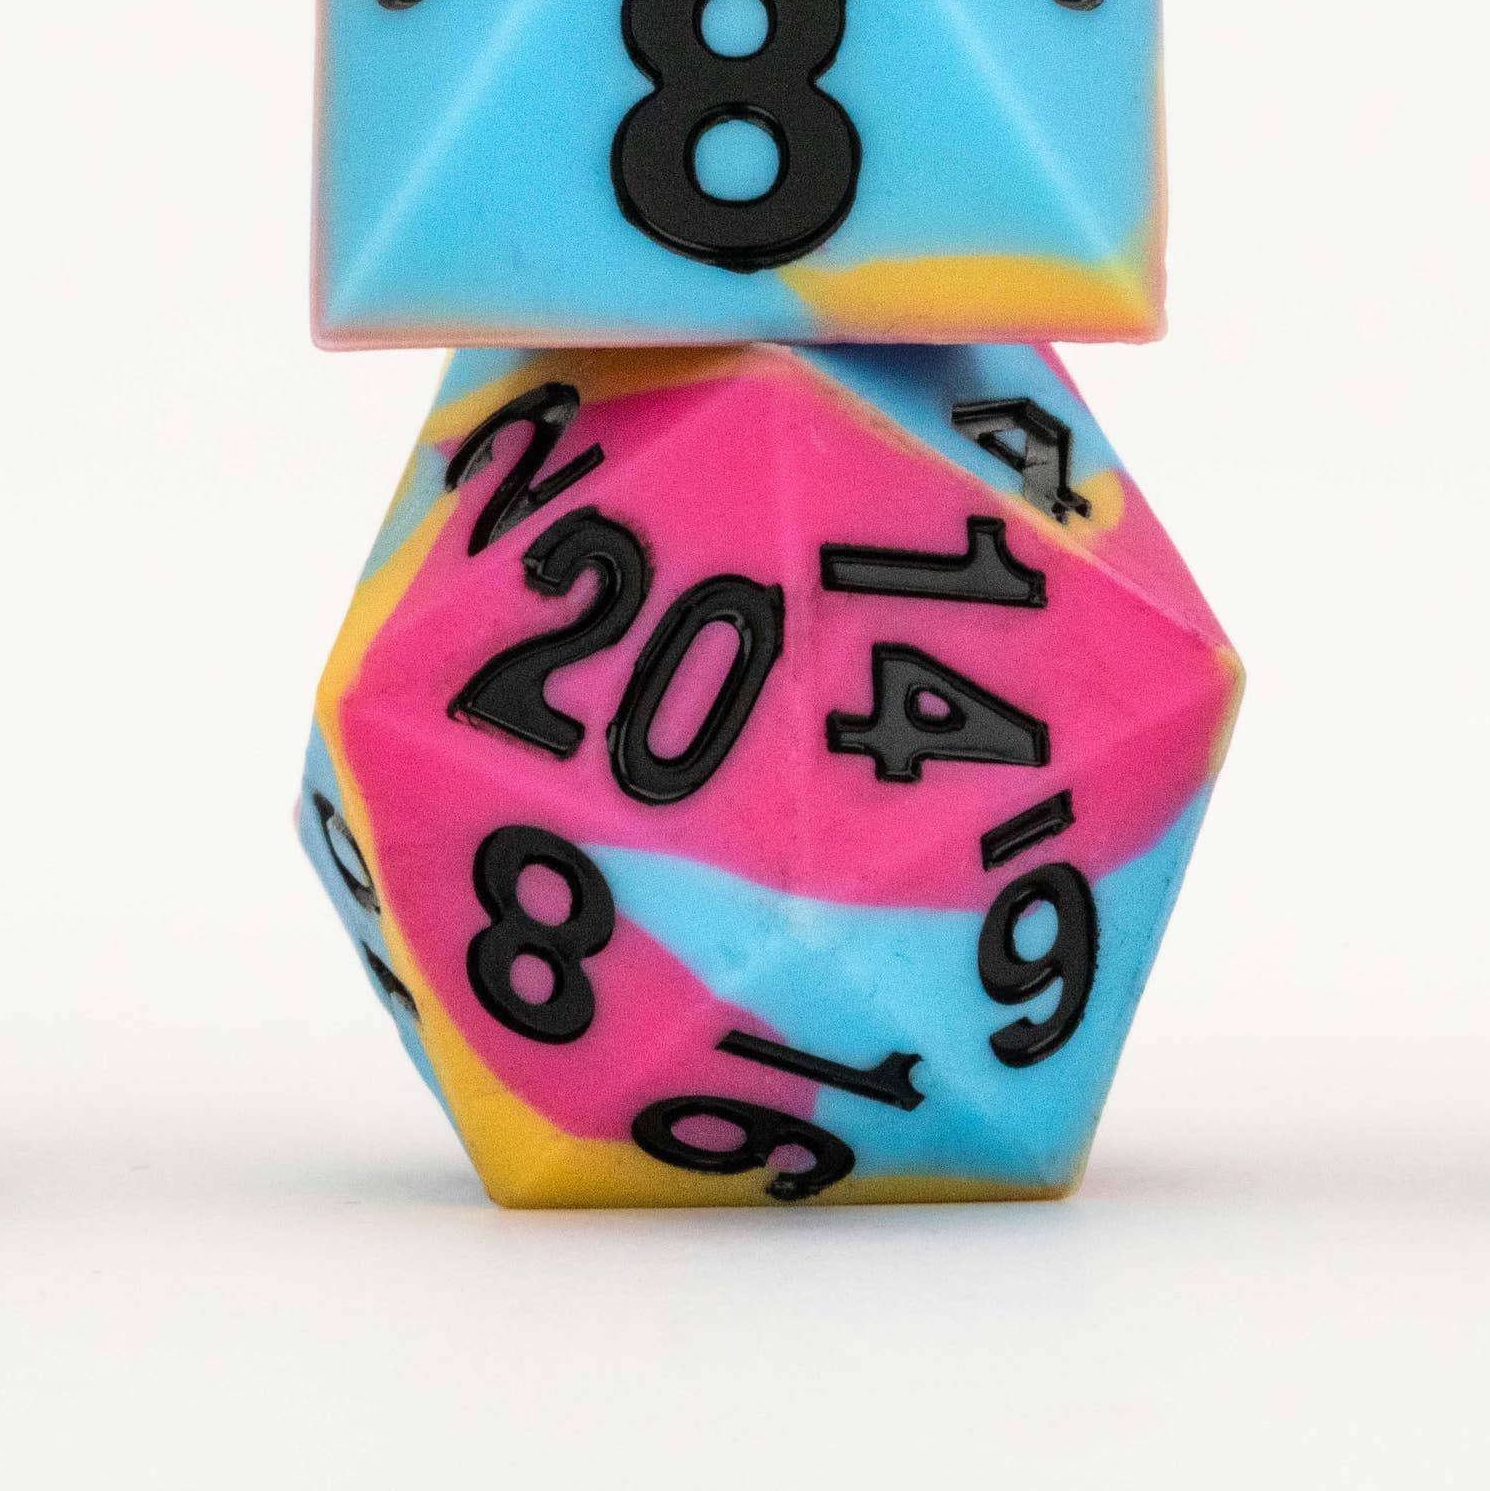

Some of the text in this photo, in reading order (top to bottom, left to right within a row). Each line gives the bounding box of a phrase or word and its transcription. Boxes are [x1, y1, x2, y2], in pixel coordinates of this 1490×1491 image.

[444, 381, 606, 557] 2
[951, 397, 1091, 525] 4
[447, 505, 786, 807] 20
[819, 515, 1051, 784] 14
[465, 824, 616, 1045] 8
